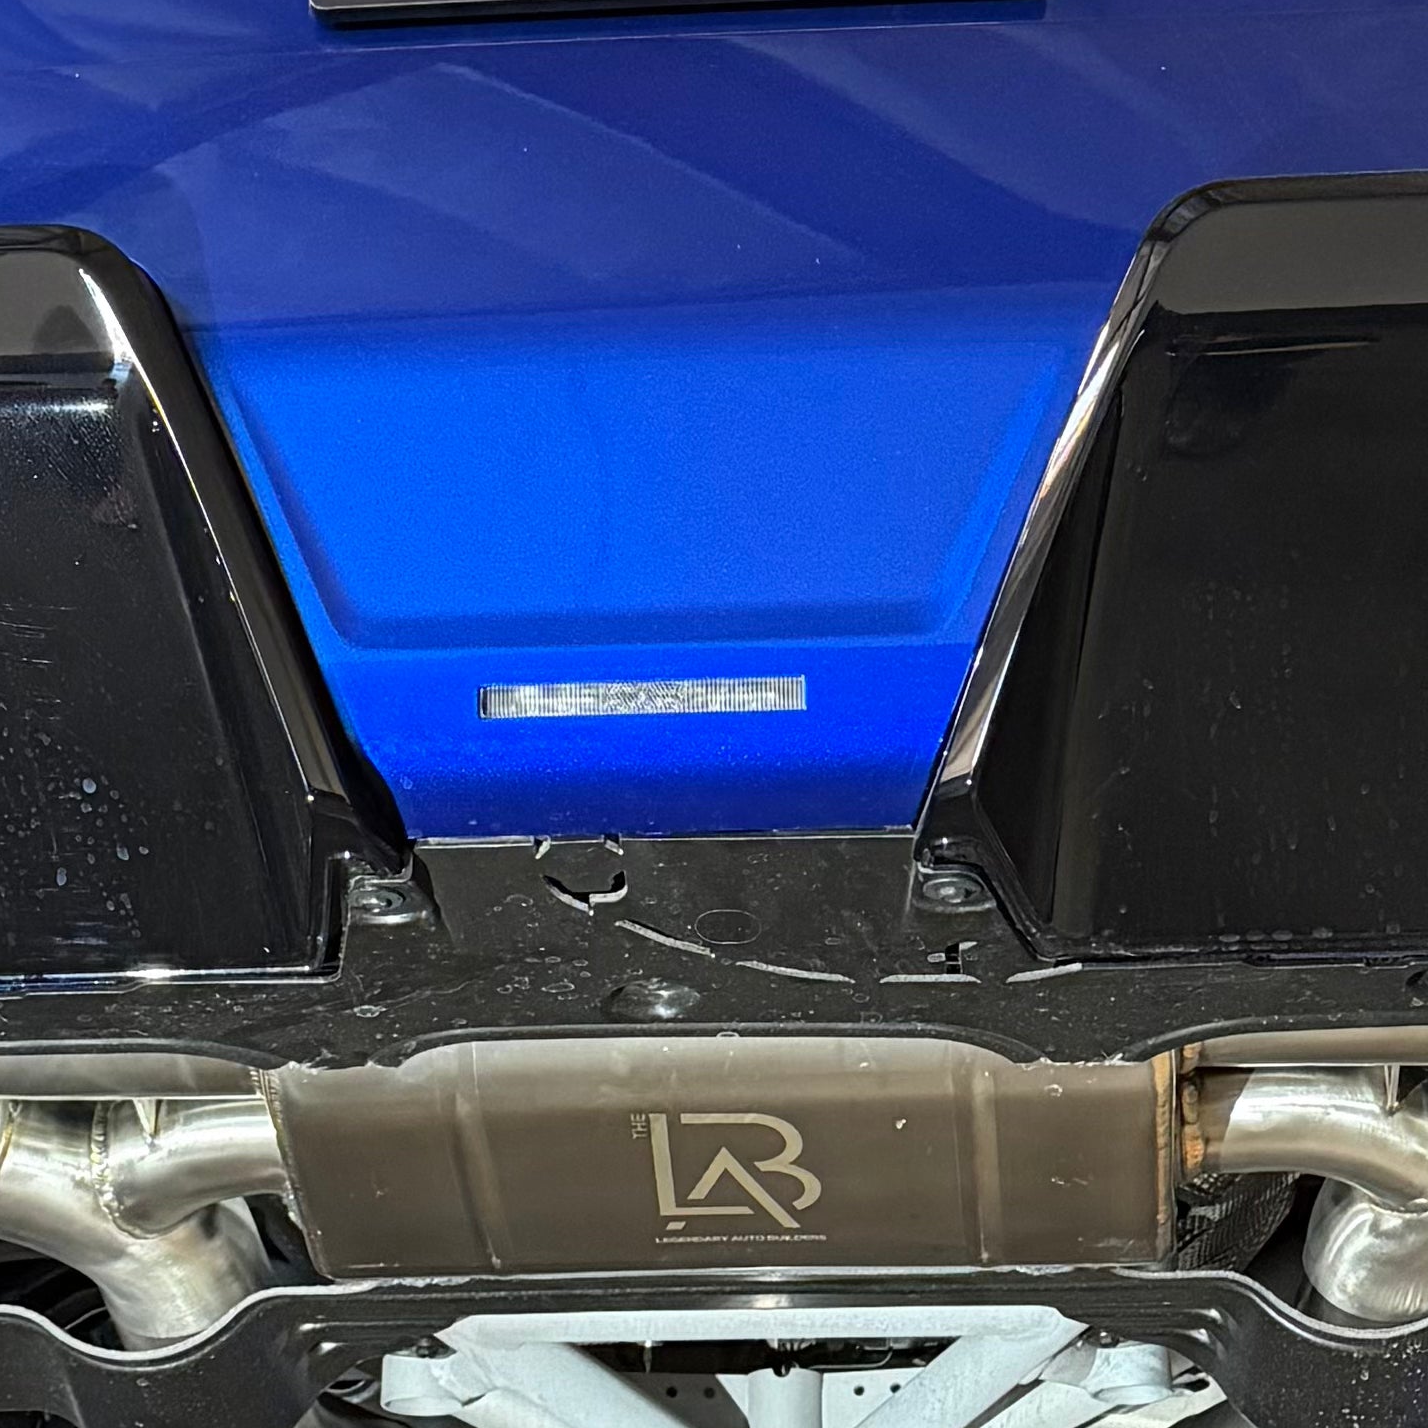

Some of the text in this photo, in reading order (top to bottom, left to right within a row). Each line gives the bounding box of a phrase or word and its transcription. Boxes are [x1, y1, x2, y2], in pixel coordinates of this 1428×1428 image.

[630, 1112, 648, 1140] THE
[655, 1233, 827, 1244] LEGENDARY AUTO BUILDERS
